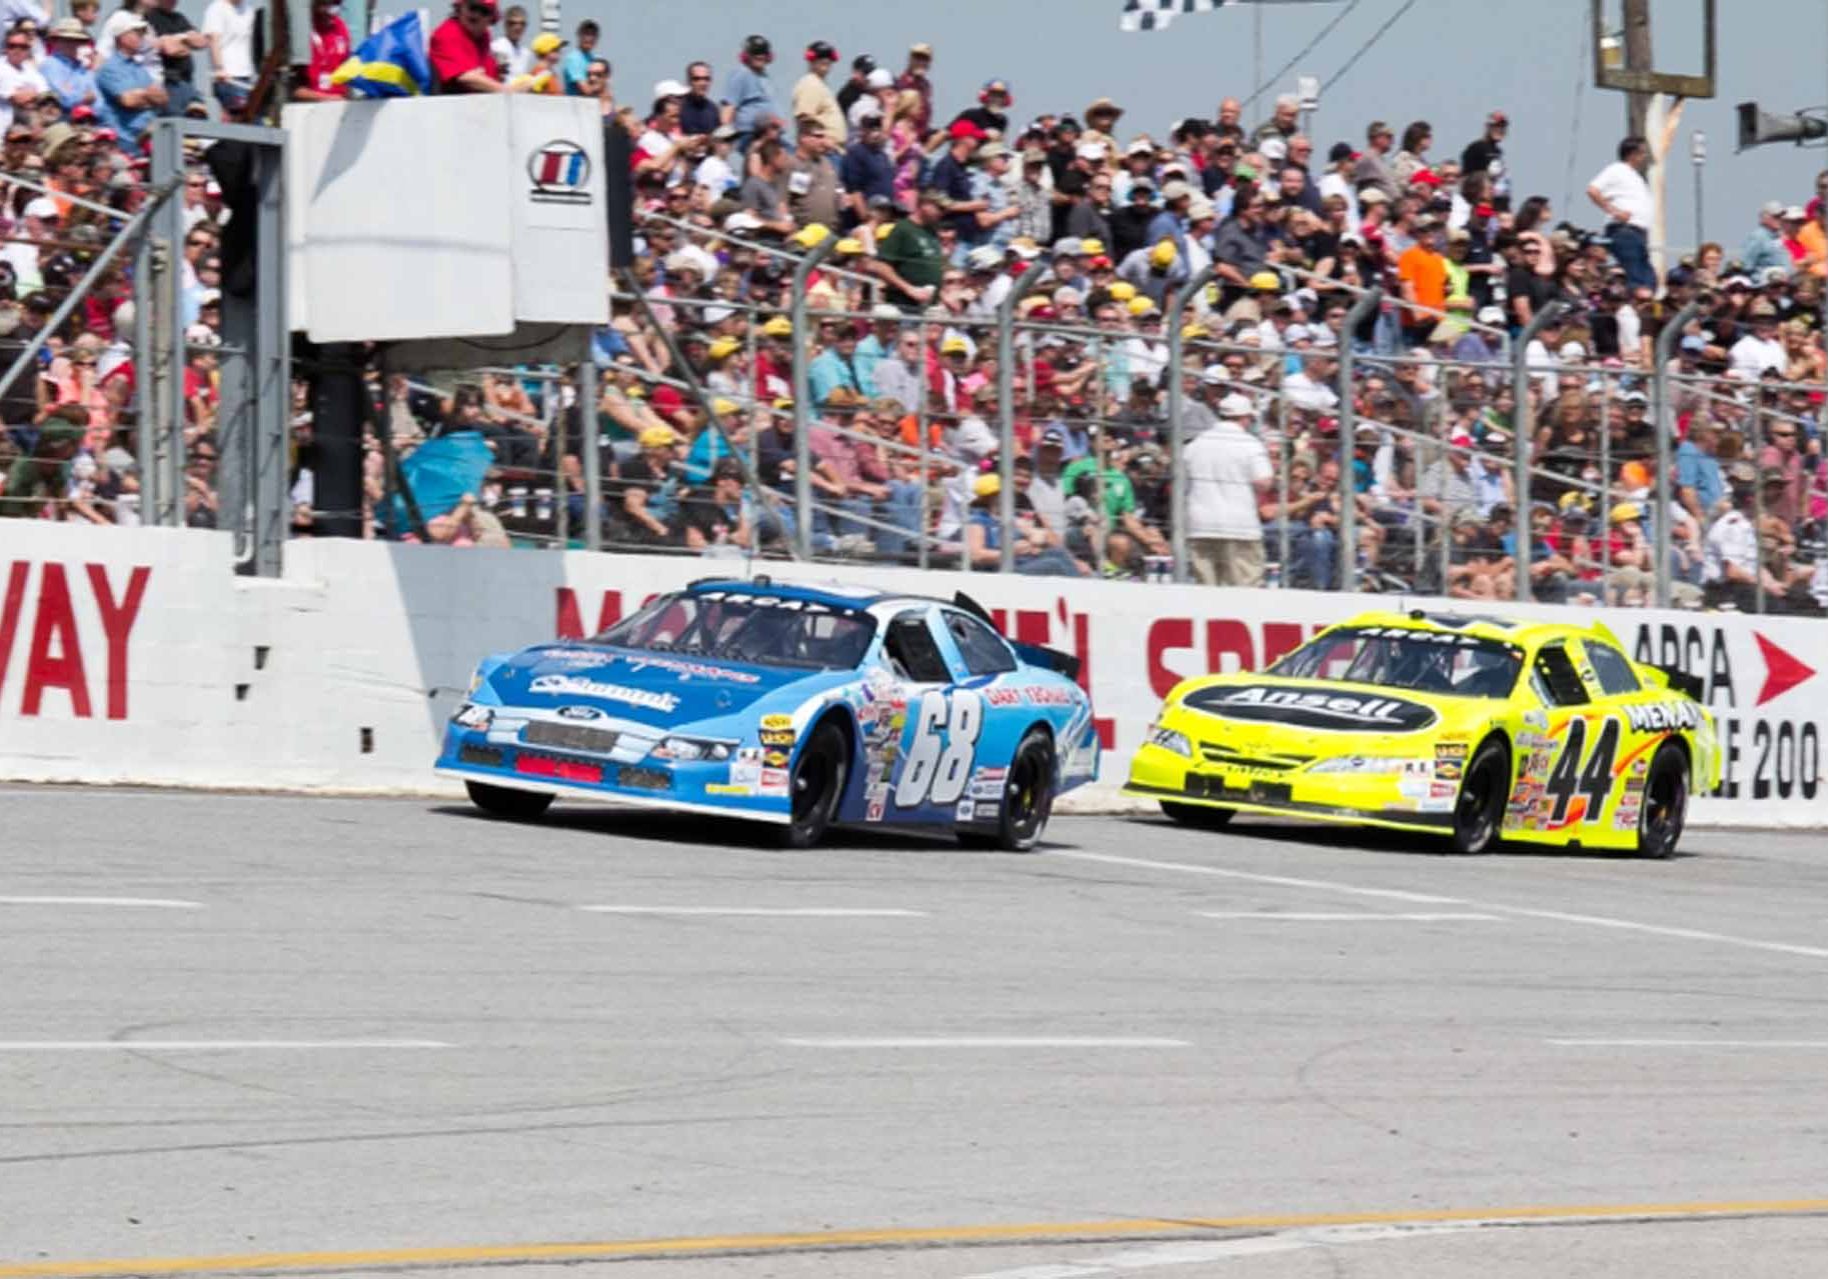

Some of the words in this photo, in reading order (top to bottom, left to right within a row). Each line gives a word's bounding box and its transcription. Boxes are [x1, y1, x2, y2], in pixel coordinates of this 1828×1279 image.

[894, 687, 984, 808] 68
[1228, 687, 1403, 719] Ansell
[1544, 714, 1622, 824] 44
[1752, 717, 1820, 800] 200
